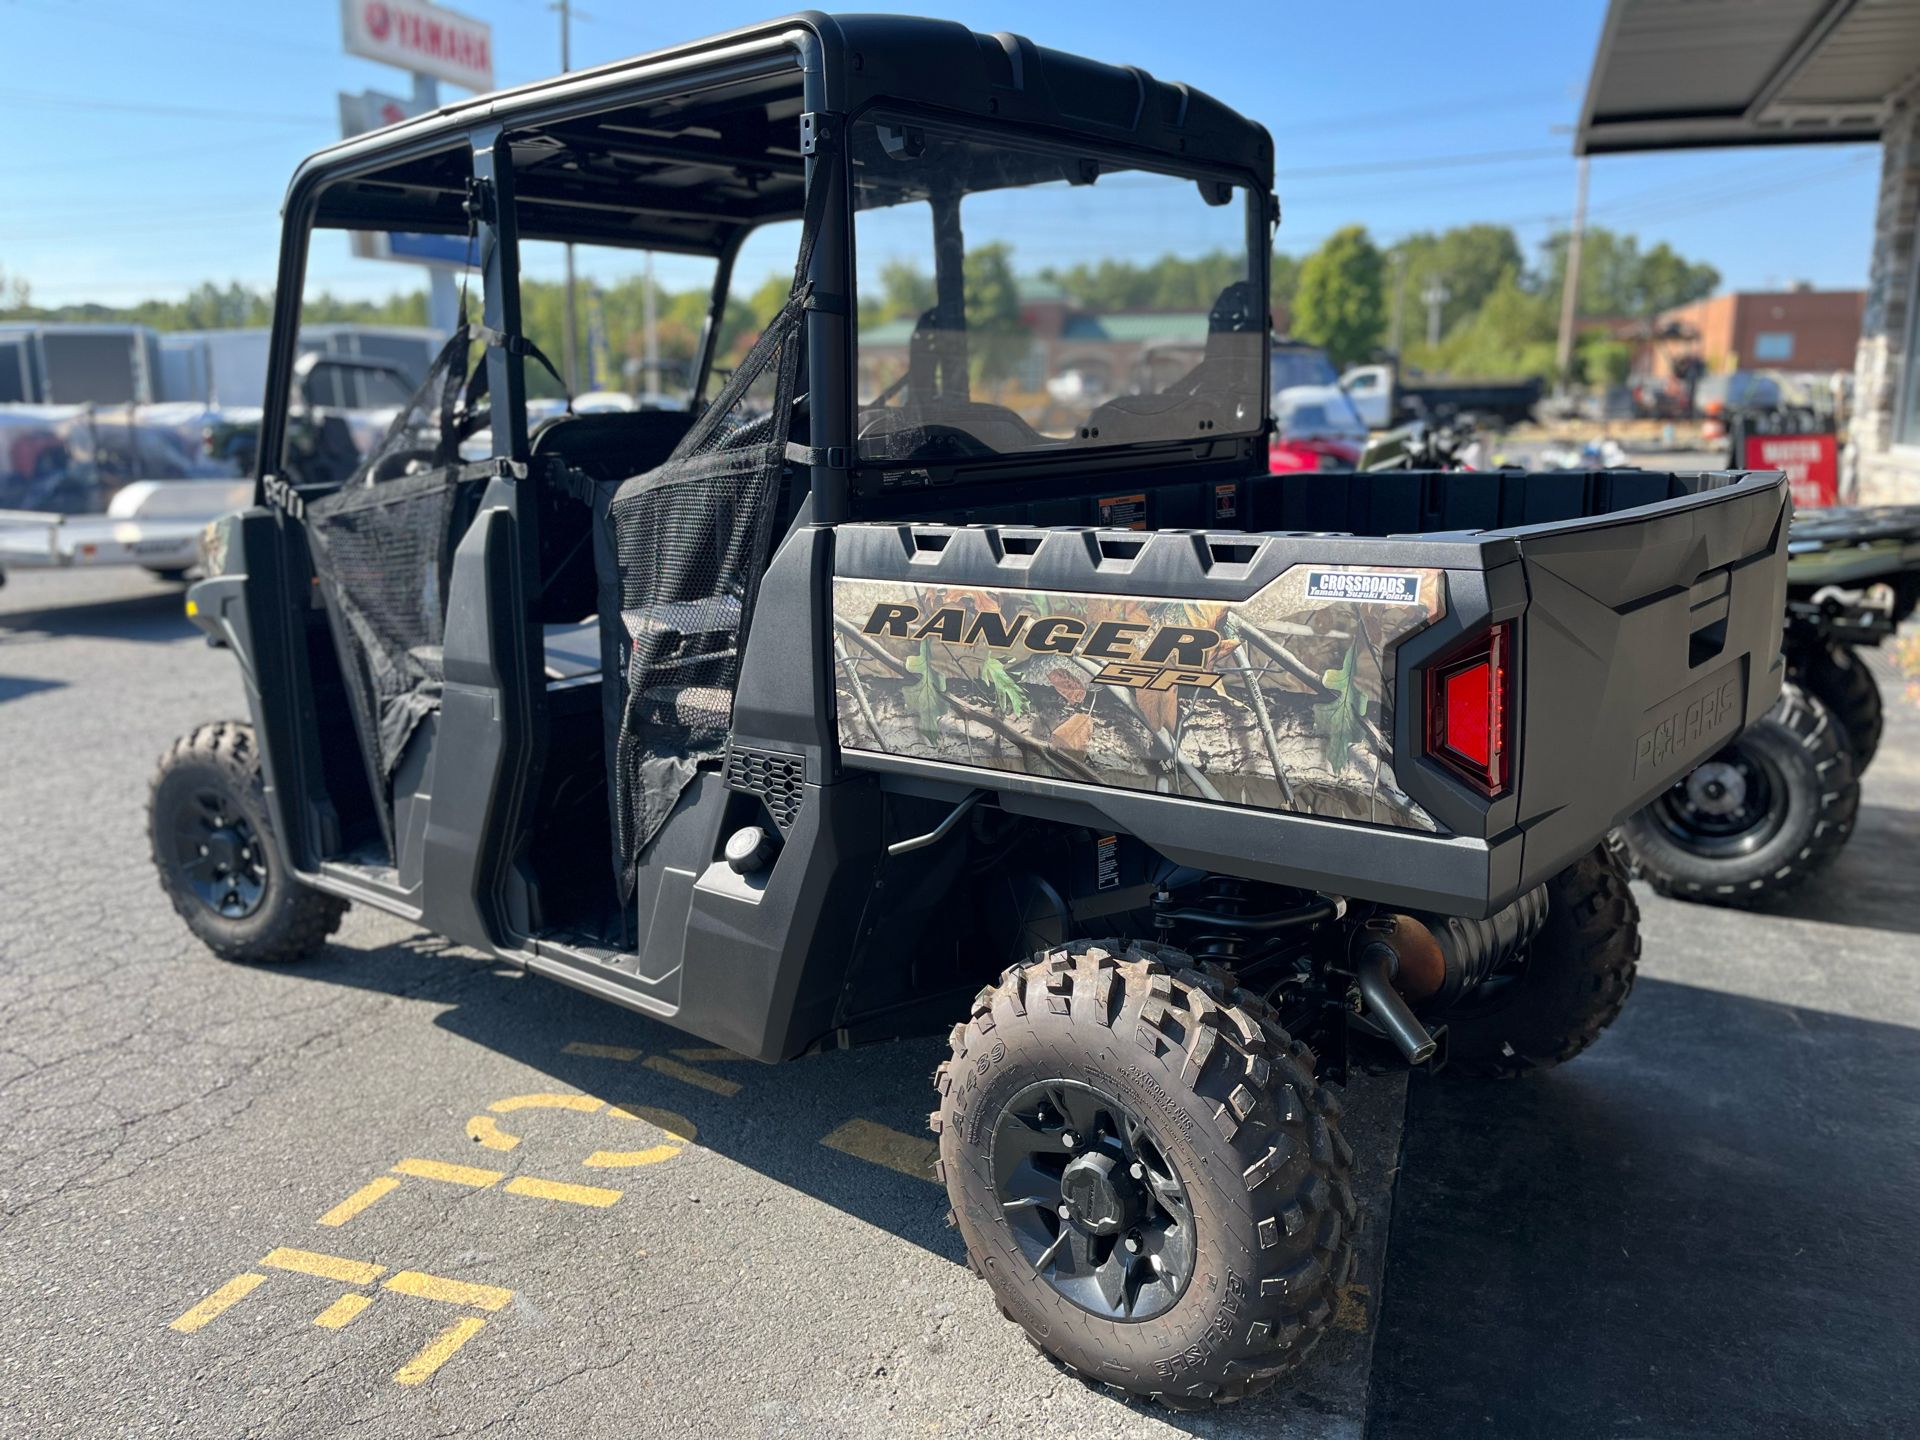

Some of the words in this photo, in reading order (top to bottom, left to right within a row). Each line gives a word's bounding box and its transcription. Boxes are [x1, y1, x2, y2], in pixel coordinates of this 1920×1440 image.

[396, 10, 489, 70] YAMAHA
[1310, 587, 1345, 597] Yamaha
[1346, 590, 1379, 599] Suzuki
[1380, 591, 1414, 601] Polaris
[1320, 574, 1405, 592] CROSSROADS
[862, 603, 1222, 668] RANGER
[1091, 662, 1225, 692] SP
[1633, 678, 1736, 781] POLARIS
[1152, 1270, 1245, 1378] CARLISLE
